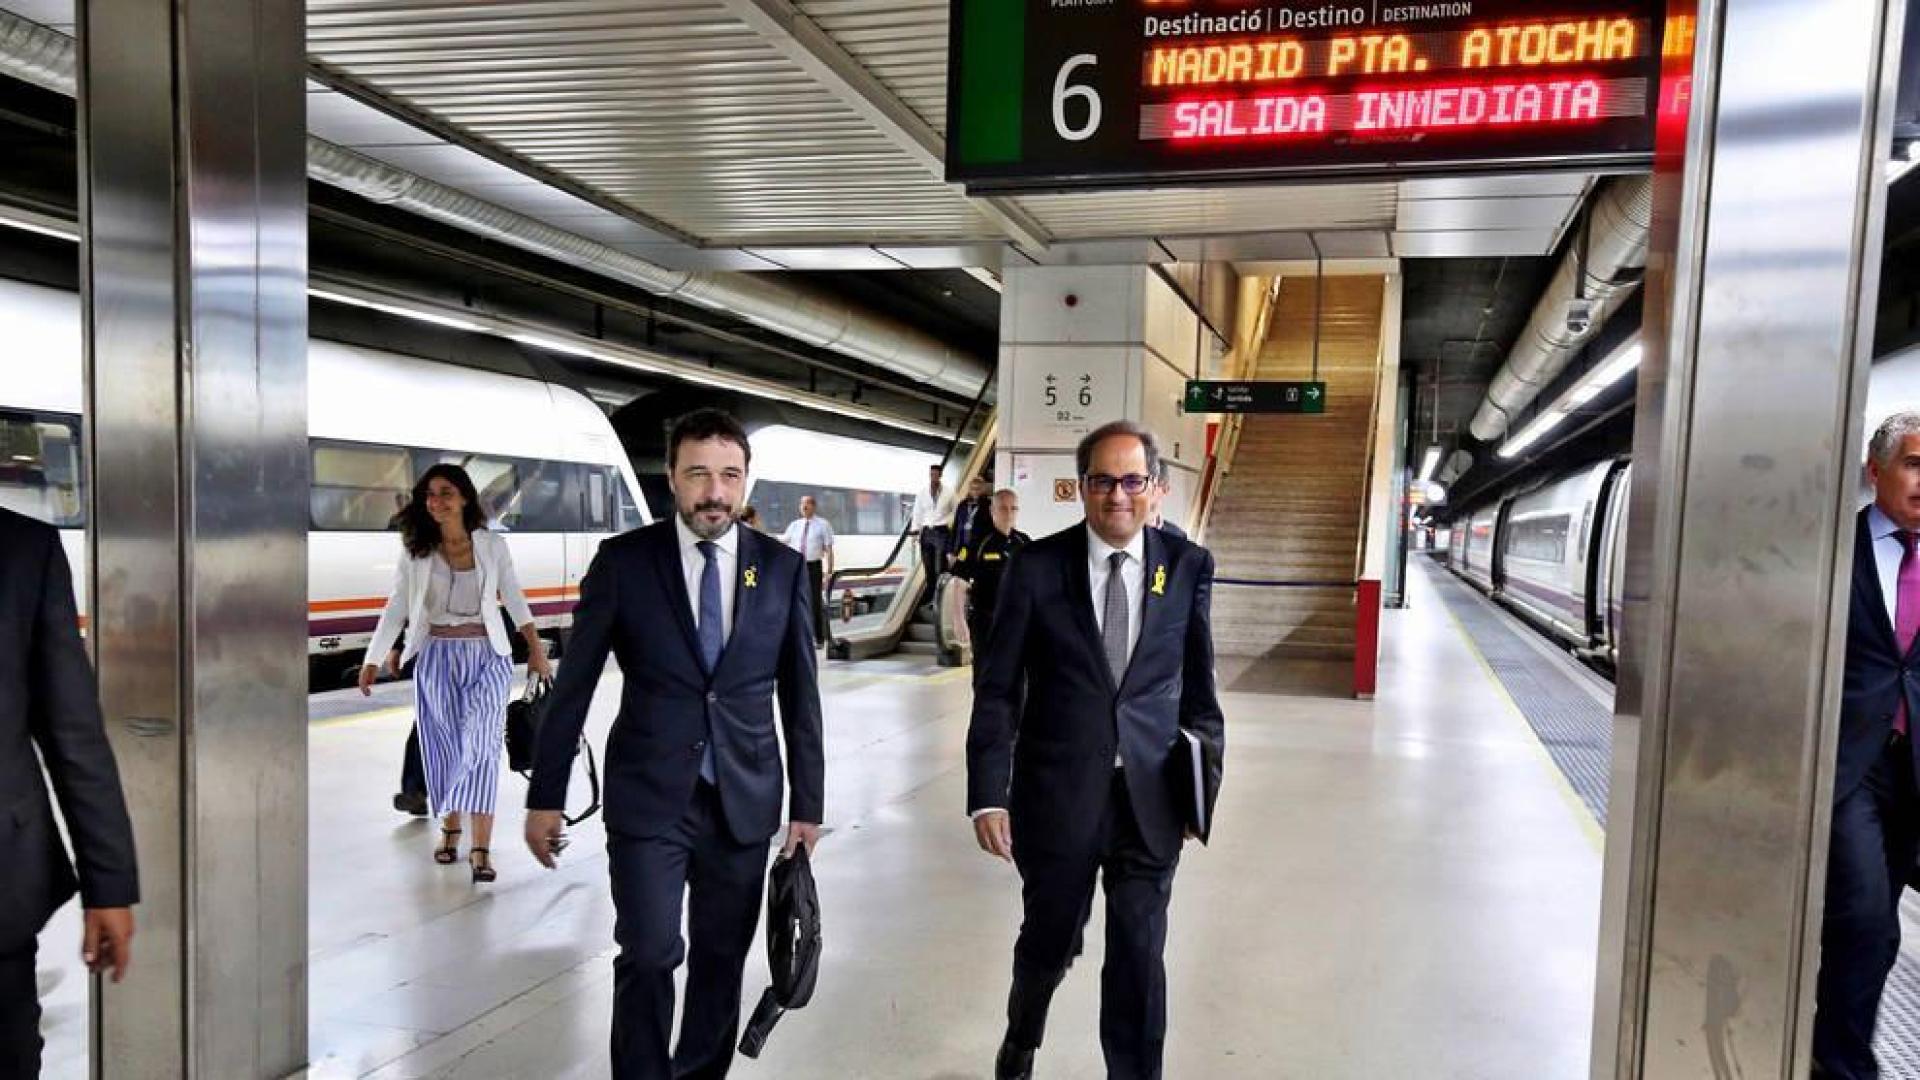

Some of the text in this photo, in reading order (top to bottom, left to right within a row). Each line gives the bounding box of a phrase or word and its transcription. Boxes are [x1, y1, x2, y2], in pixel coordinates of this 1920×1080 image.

[1144, 1, 1472, 37] Destinació Destino DESTINATION
[1151, 41, 1304, 85] MADRID
[1328, 35, 1428, 76] PTA.
[1462, 18, 1634, 68] ATOCHA
[1053, 53, 1102, 141] 6
[1173, 79, 1600, 138] SALIDA INMEDIATA
[1045, 385, 1092, 407] 5 6
